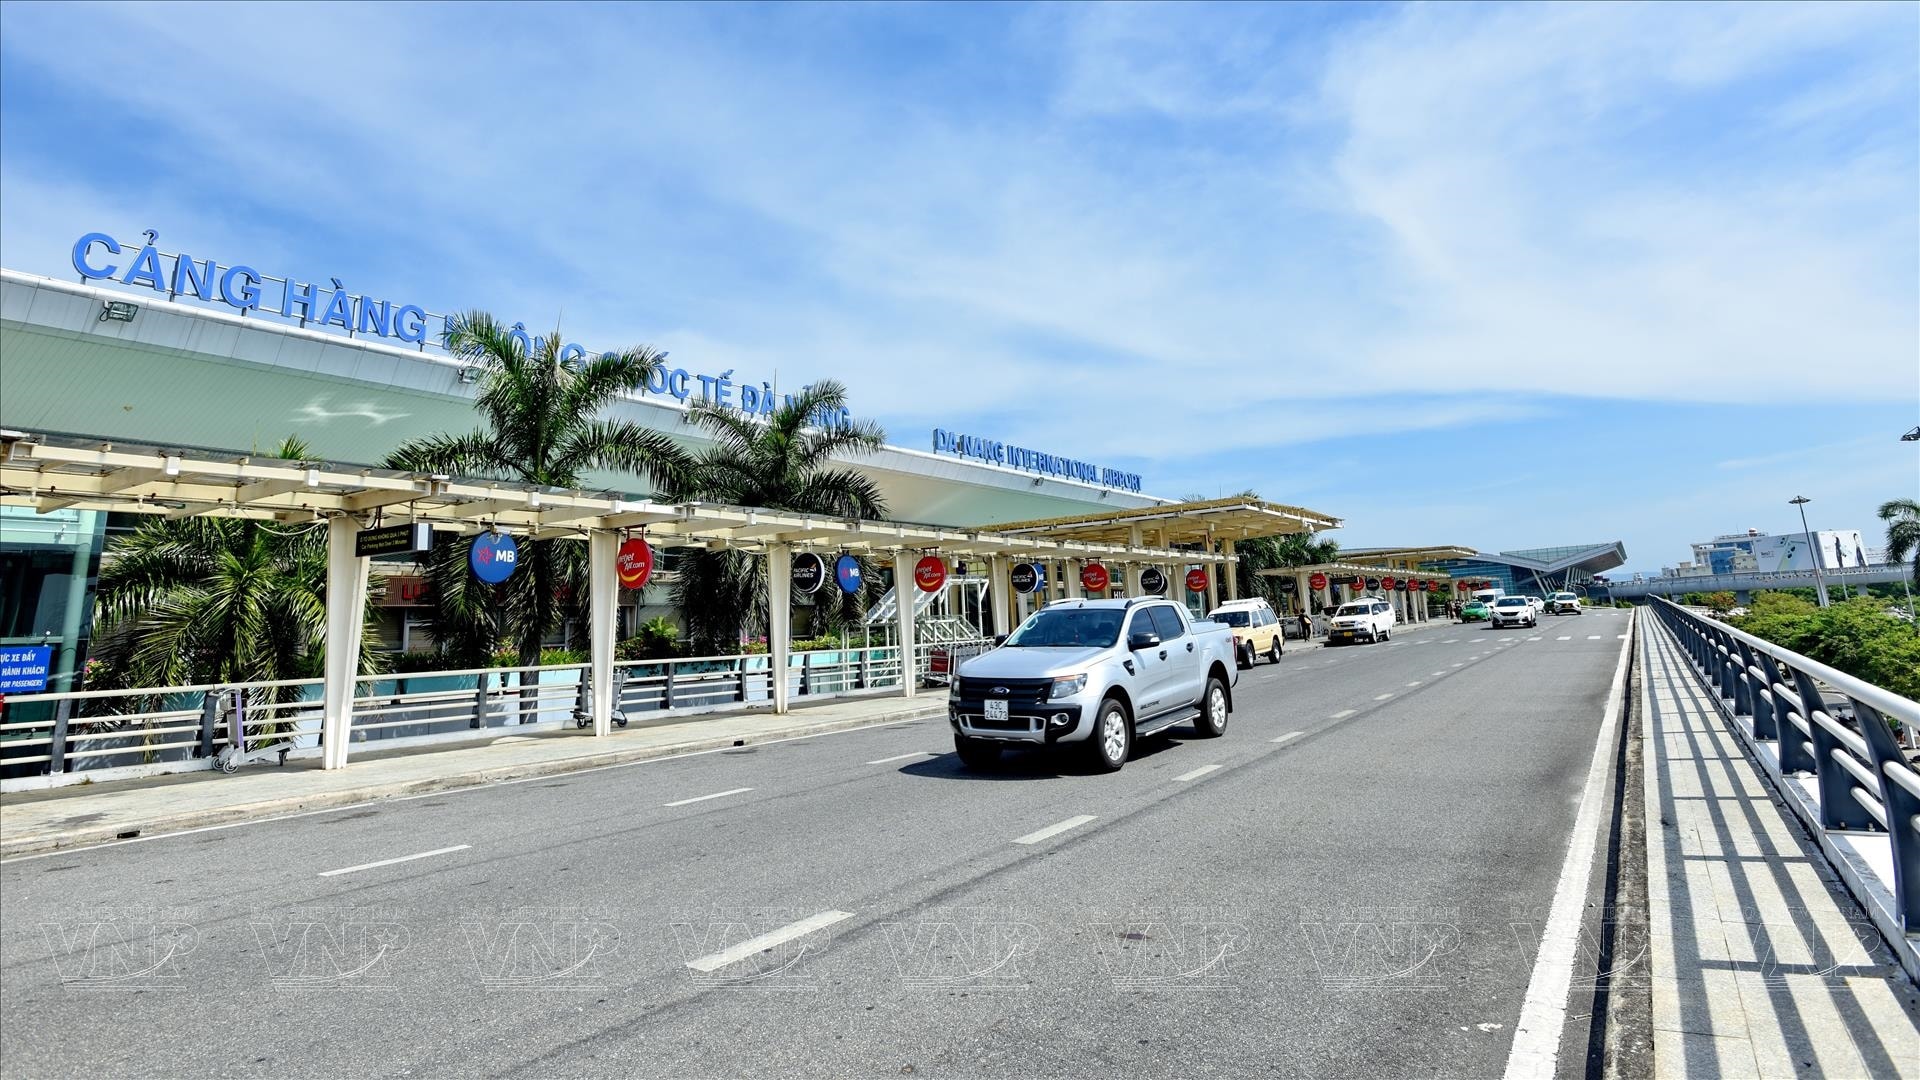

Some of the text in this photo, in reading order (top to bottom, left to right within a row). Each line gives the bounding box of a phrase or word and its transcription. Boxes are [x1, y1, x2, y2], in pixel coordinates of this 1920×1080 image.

[72, 229, 262, 312] CẢNG
[281, 278, 427, 344] HÀNG
[697, 369, 735, 408] TẾ
[741, 381, 775, 415] ĐÀ
[933, 428, 1142, 491] DA NANG INTERNATIONAL AIRPORT
[495, 549, 515, 563] MB
[11, 653, 21, 663] XE
[11, 679, 44, 688] PASSENGERS
